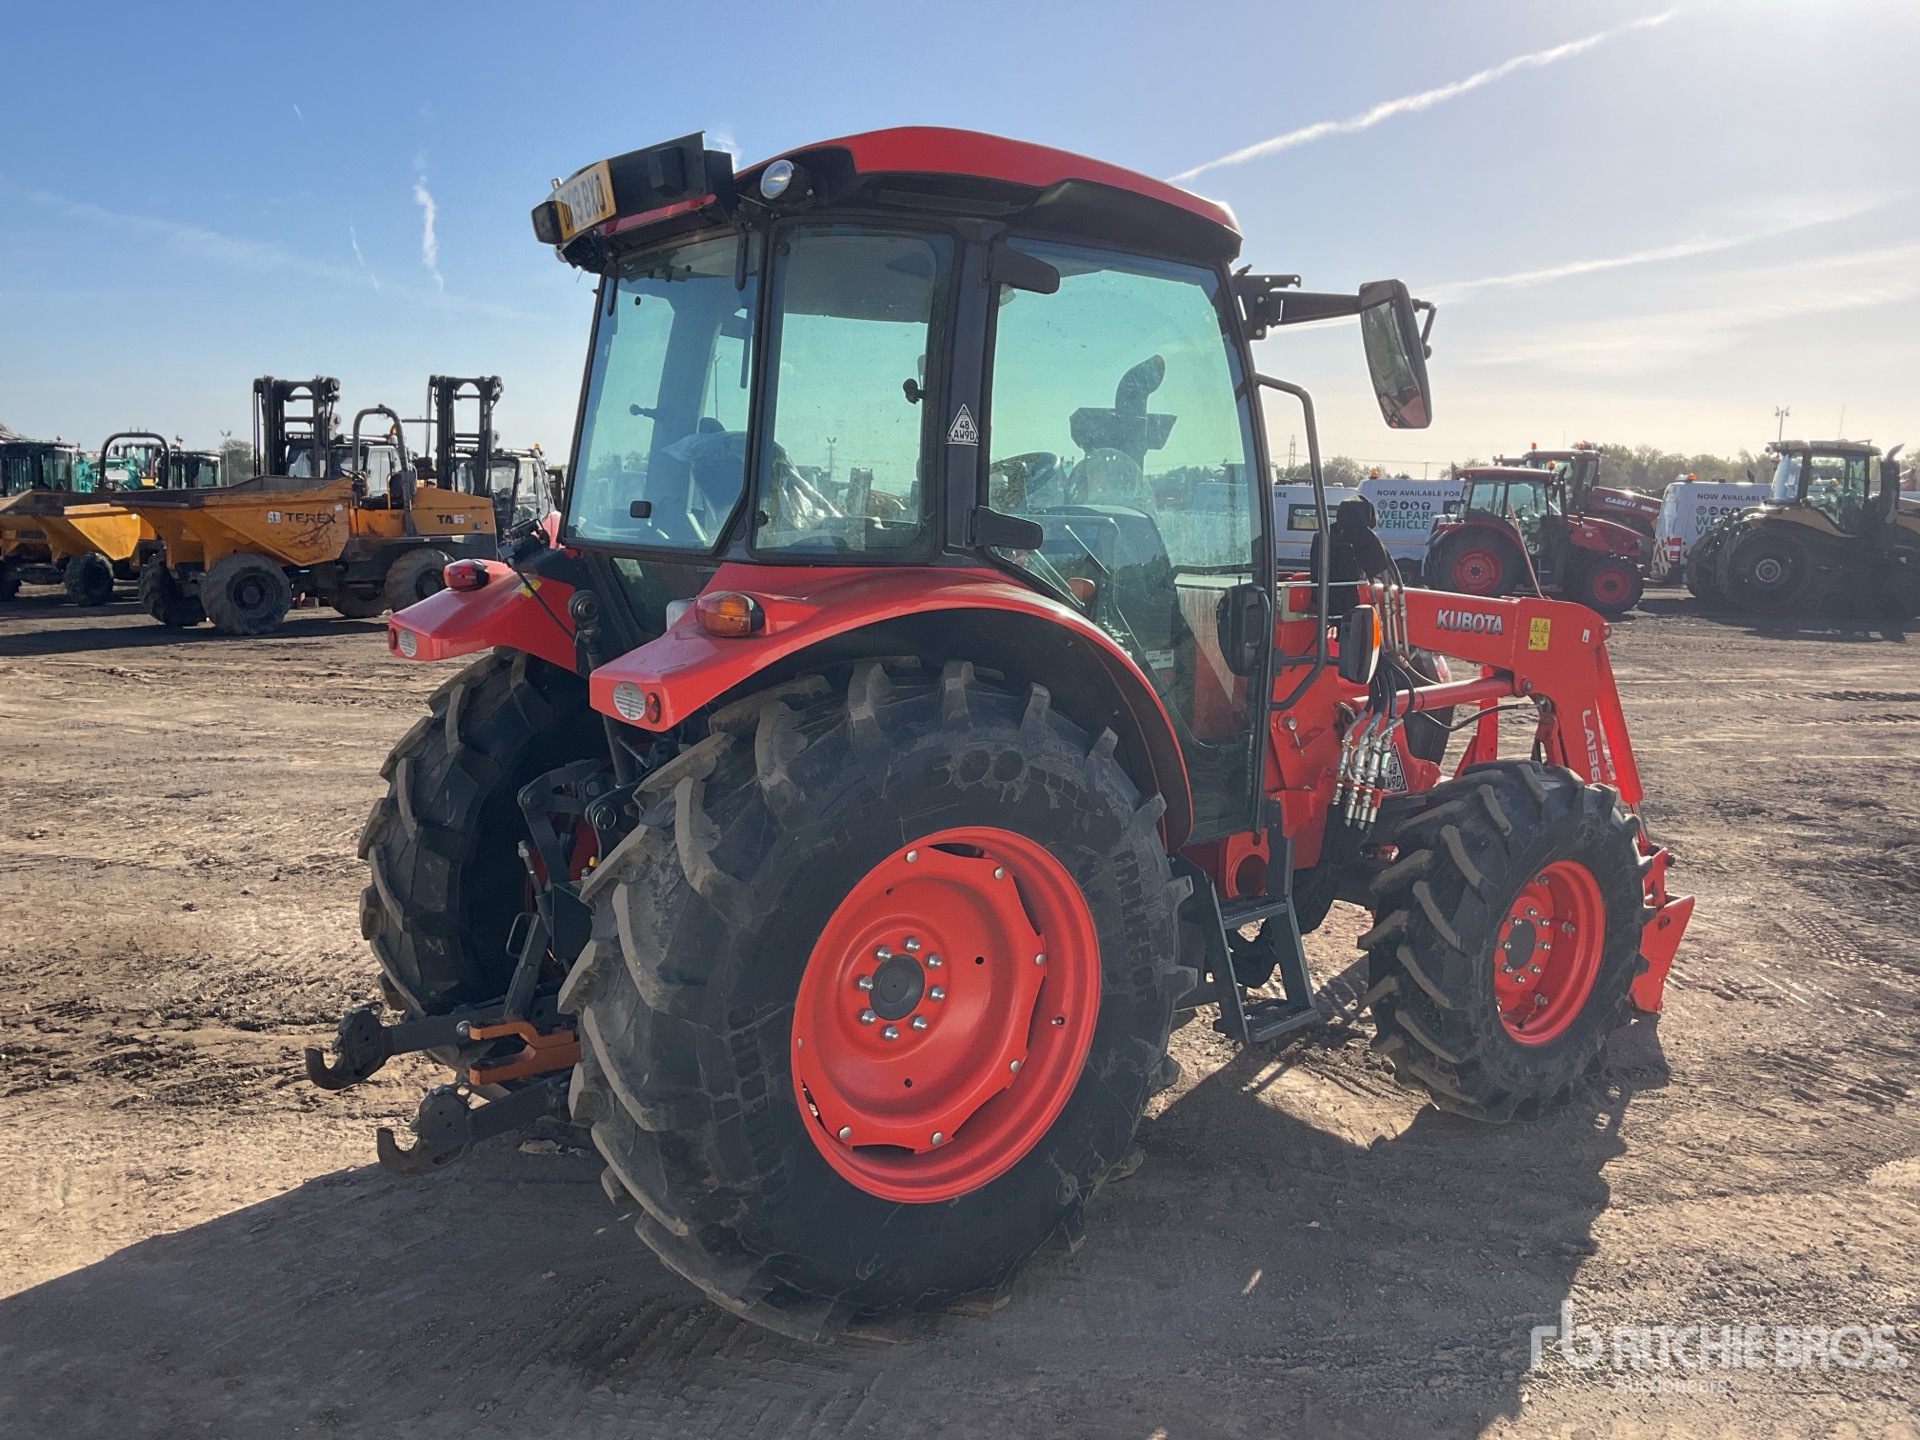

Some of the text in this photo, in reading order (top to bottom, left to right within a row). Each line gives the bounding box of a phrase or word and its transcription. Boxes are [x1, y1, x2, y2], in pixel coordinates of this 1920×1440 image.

[960, 421, 970, 430] 48
[285, 512, 336, 524] TEREX
[1377, 520, 1430, 529] VEHICLE
[1436, 608, 1504, 636] KUBOTA
